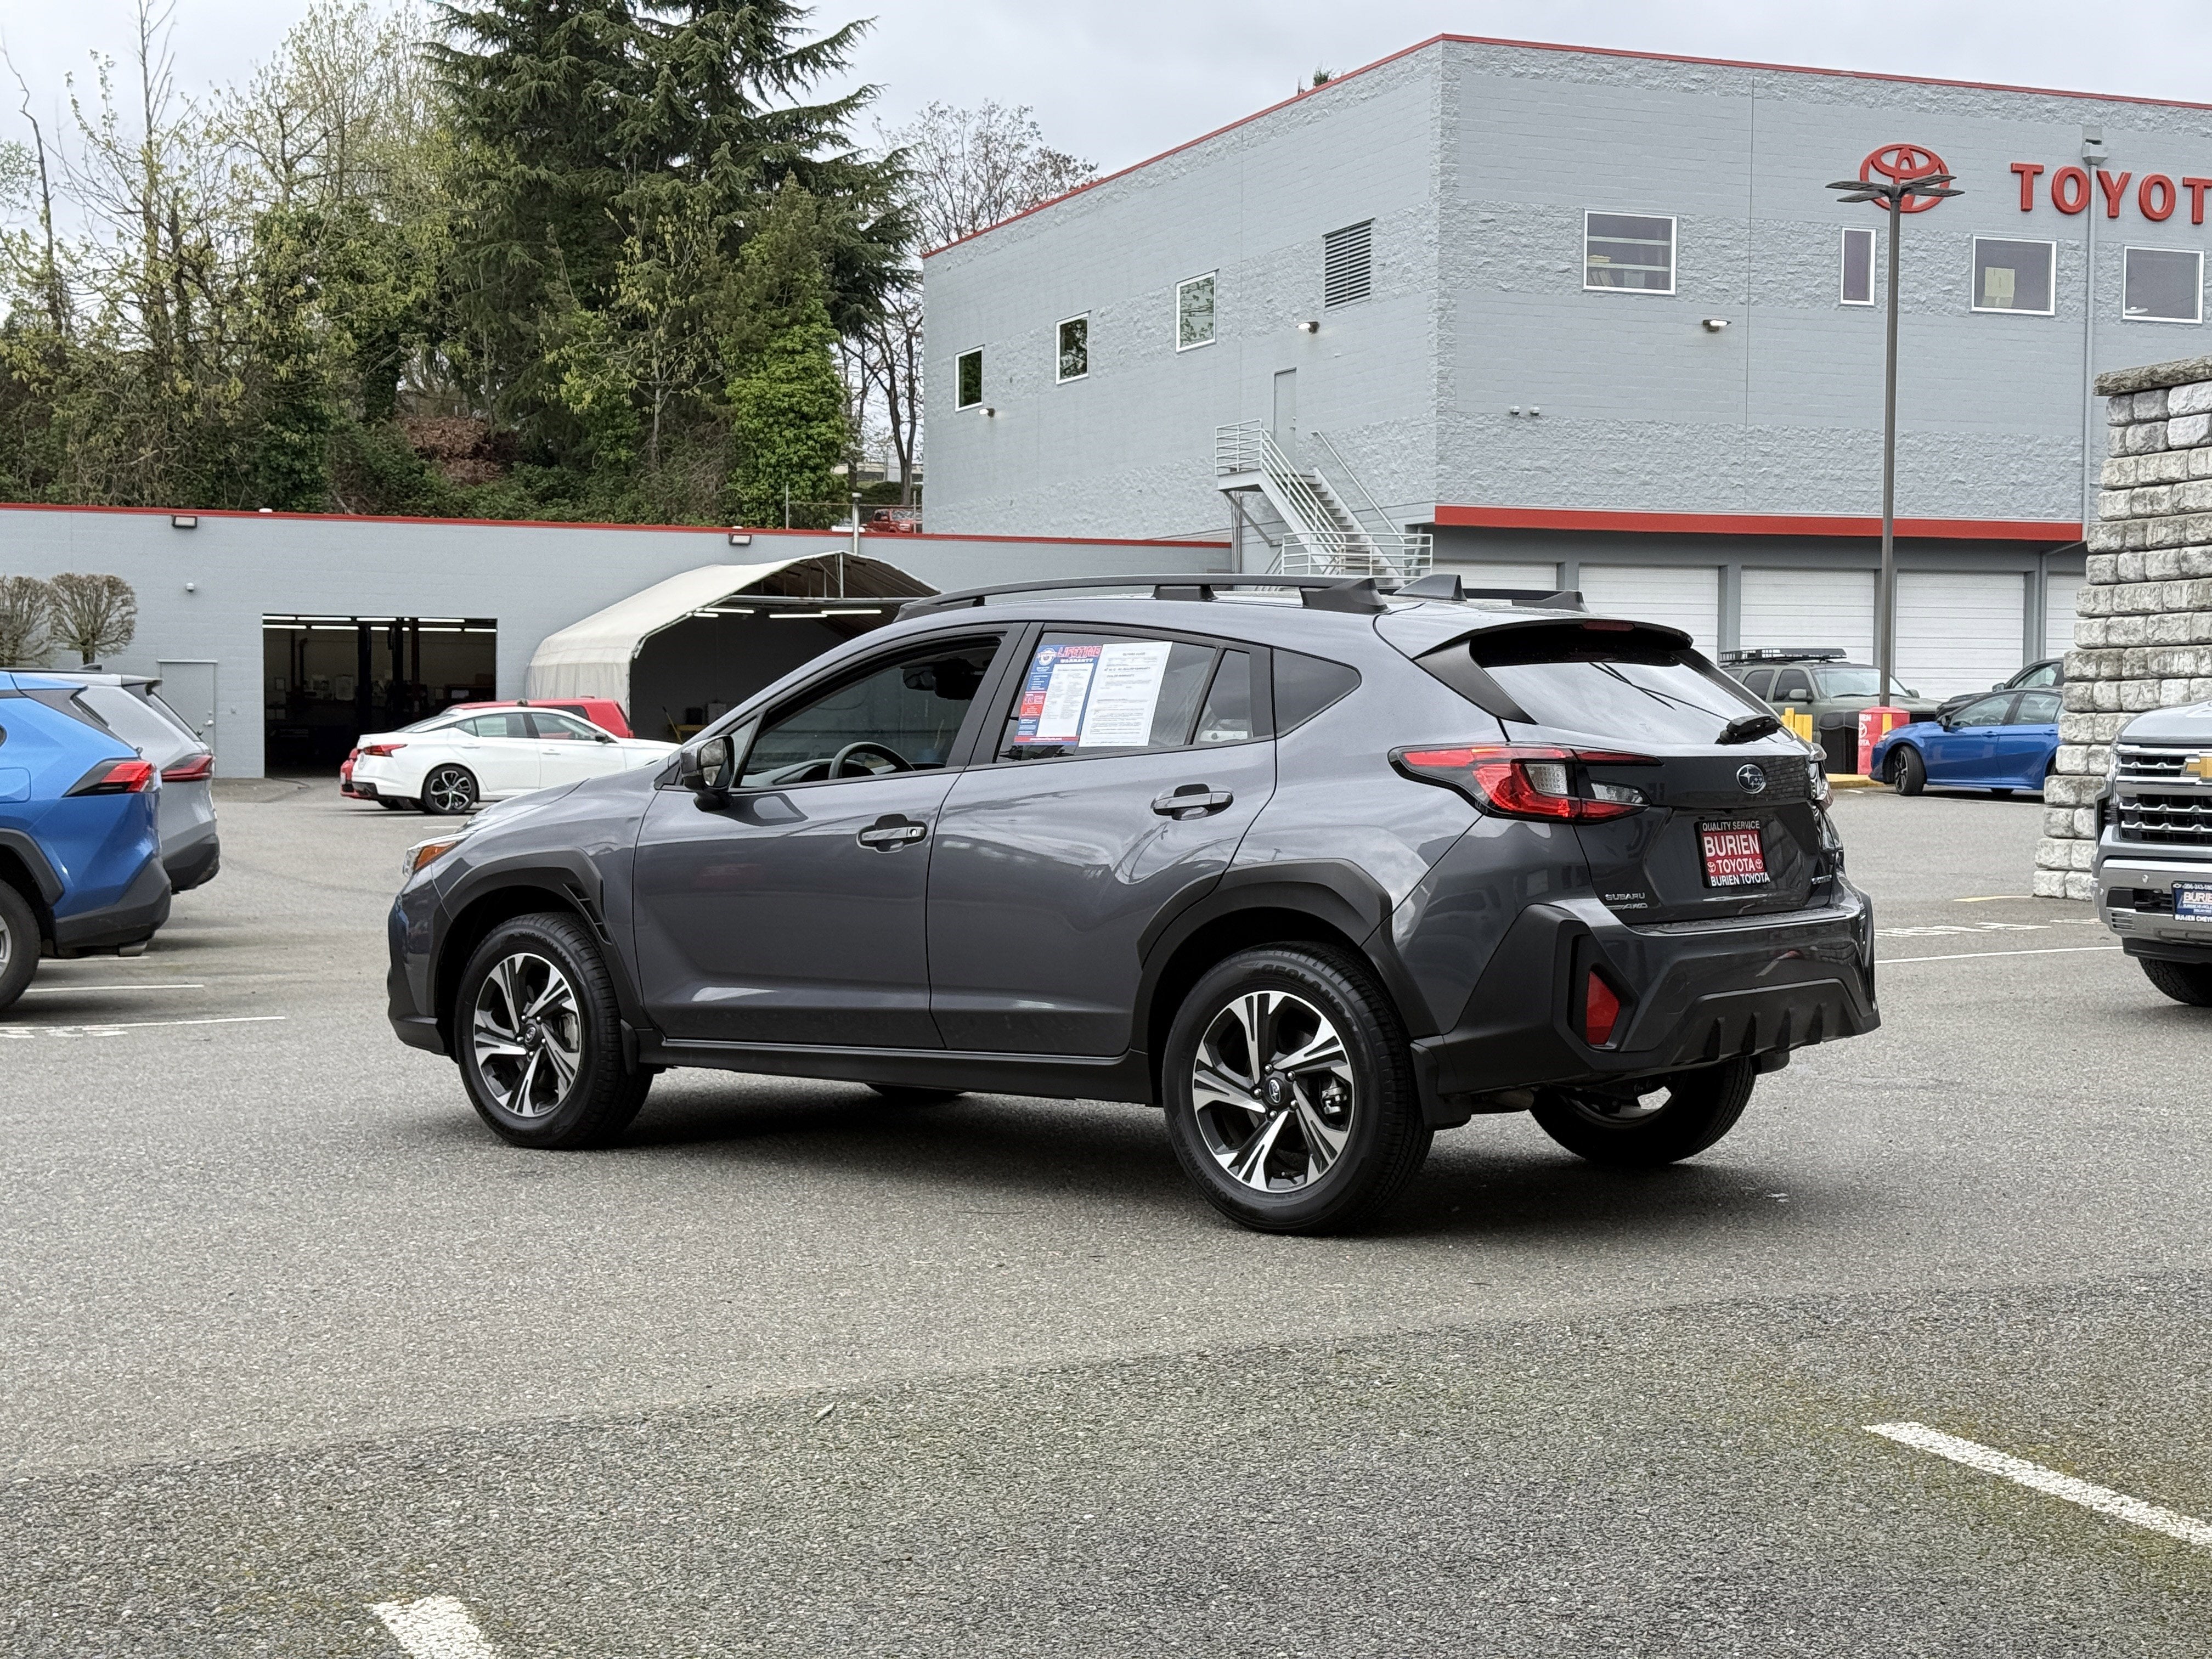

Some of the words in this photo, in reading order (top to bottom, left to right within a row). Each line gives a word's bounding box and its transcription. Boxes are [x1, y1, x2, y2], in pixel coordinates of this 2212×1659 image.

[1058, 645, 1102, 658] LIFETIME
[1702, 822, 1731, 832] QUALITY
[1733, 821, 1760, 830] SERVICE
[1703, 834, 1760, 857] BURIEN
[1716, 857, 1756, 873] TOYOTA
[1711, 874, 1740, 887] BURIEN
[1740, 872, 1770, 884] TOYOTA
[1605, 893, 1645, 901] SUBARU
